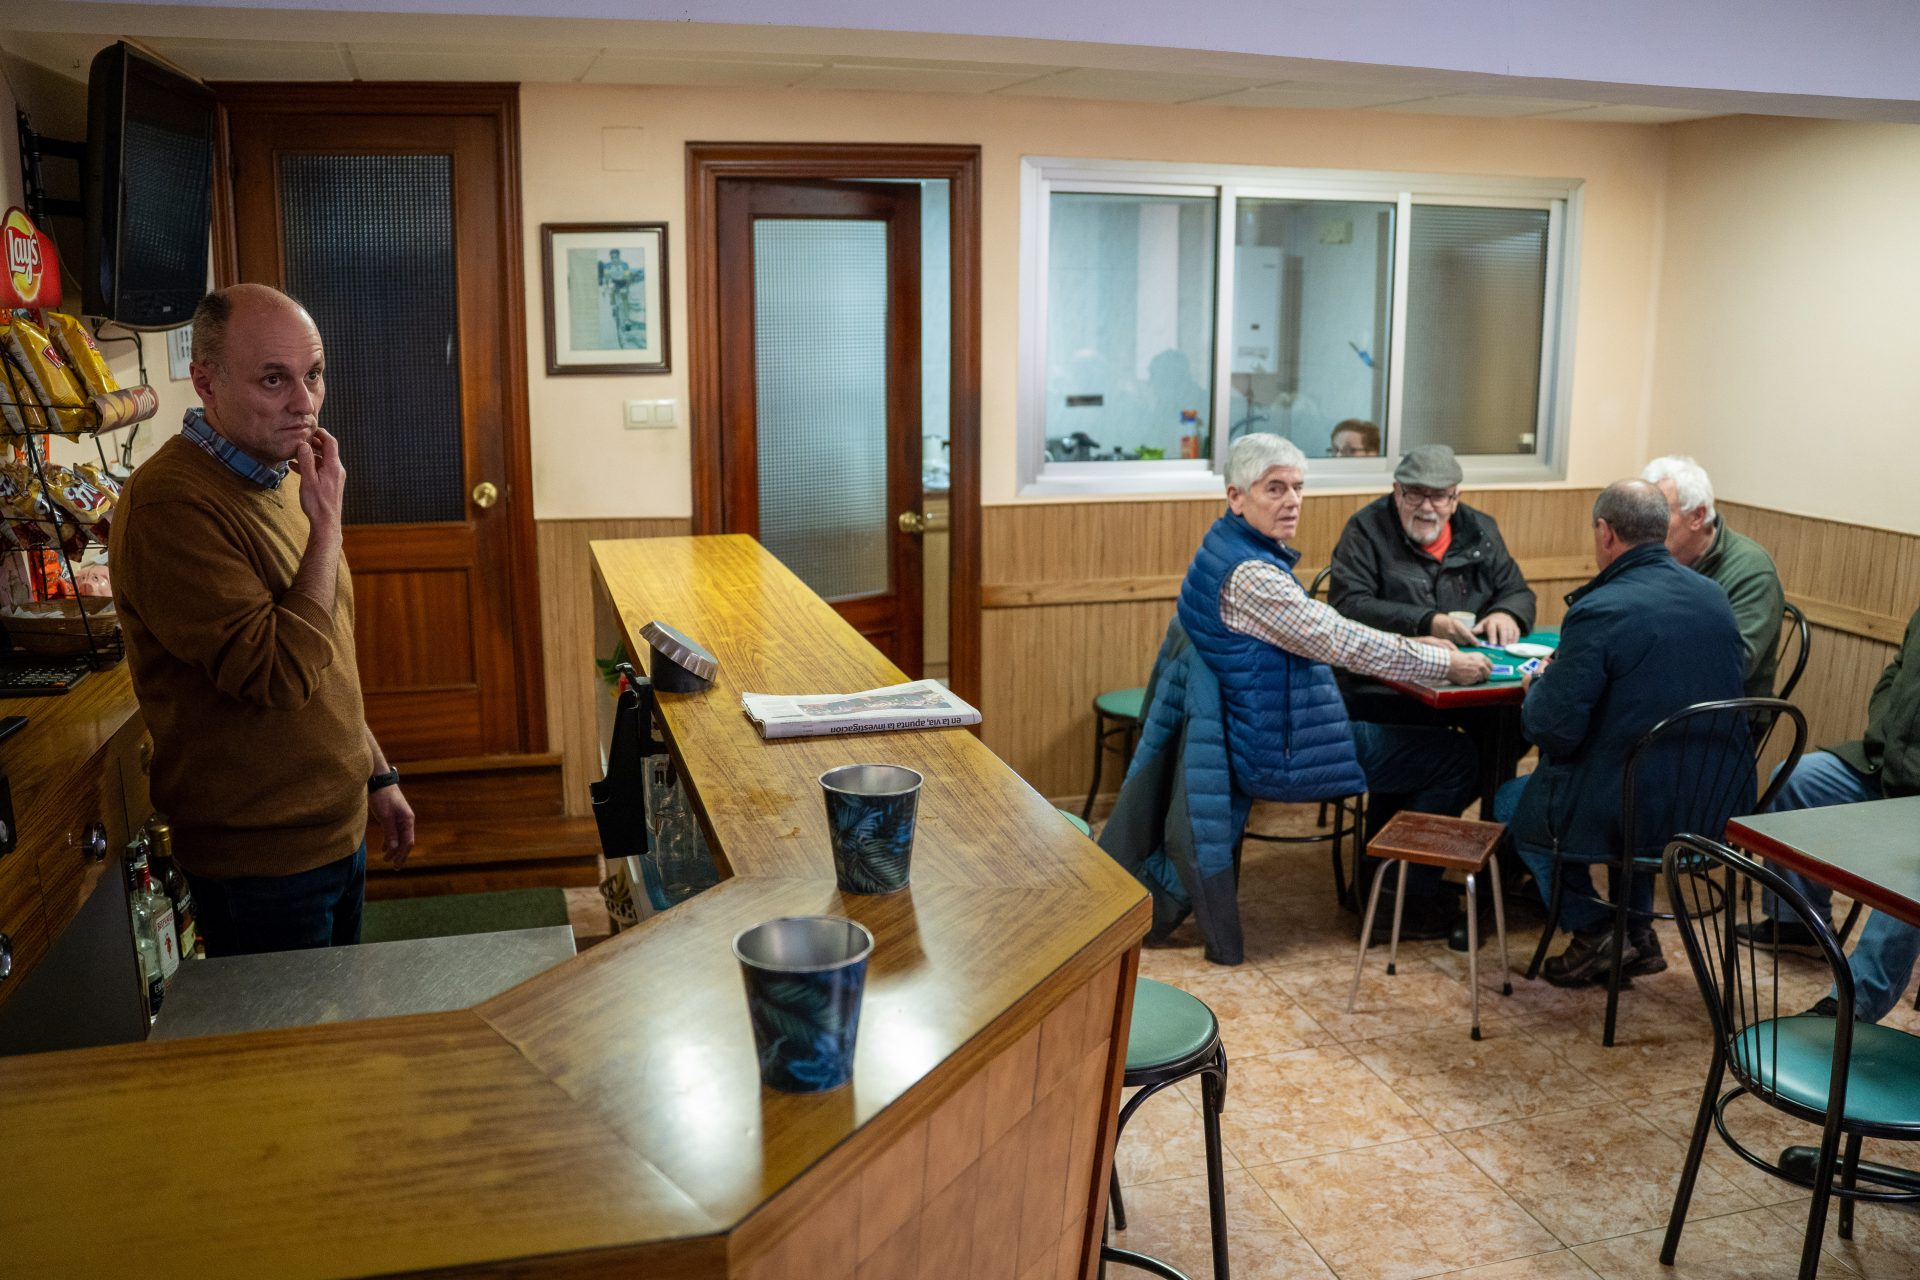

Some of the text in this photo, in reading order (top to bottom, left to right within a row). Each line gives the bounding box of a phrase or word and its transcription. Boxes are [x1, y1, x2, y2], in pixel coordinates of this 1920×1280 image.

[8, 229, 39, 284] Lay's
[887, 722, 895, 730] la
[896, 718, 926, 729] apunta
[942, 718, 950, 726] la
